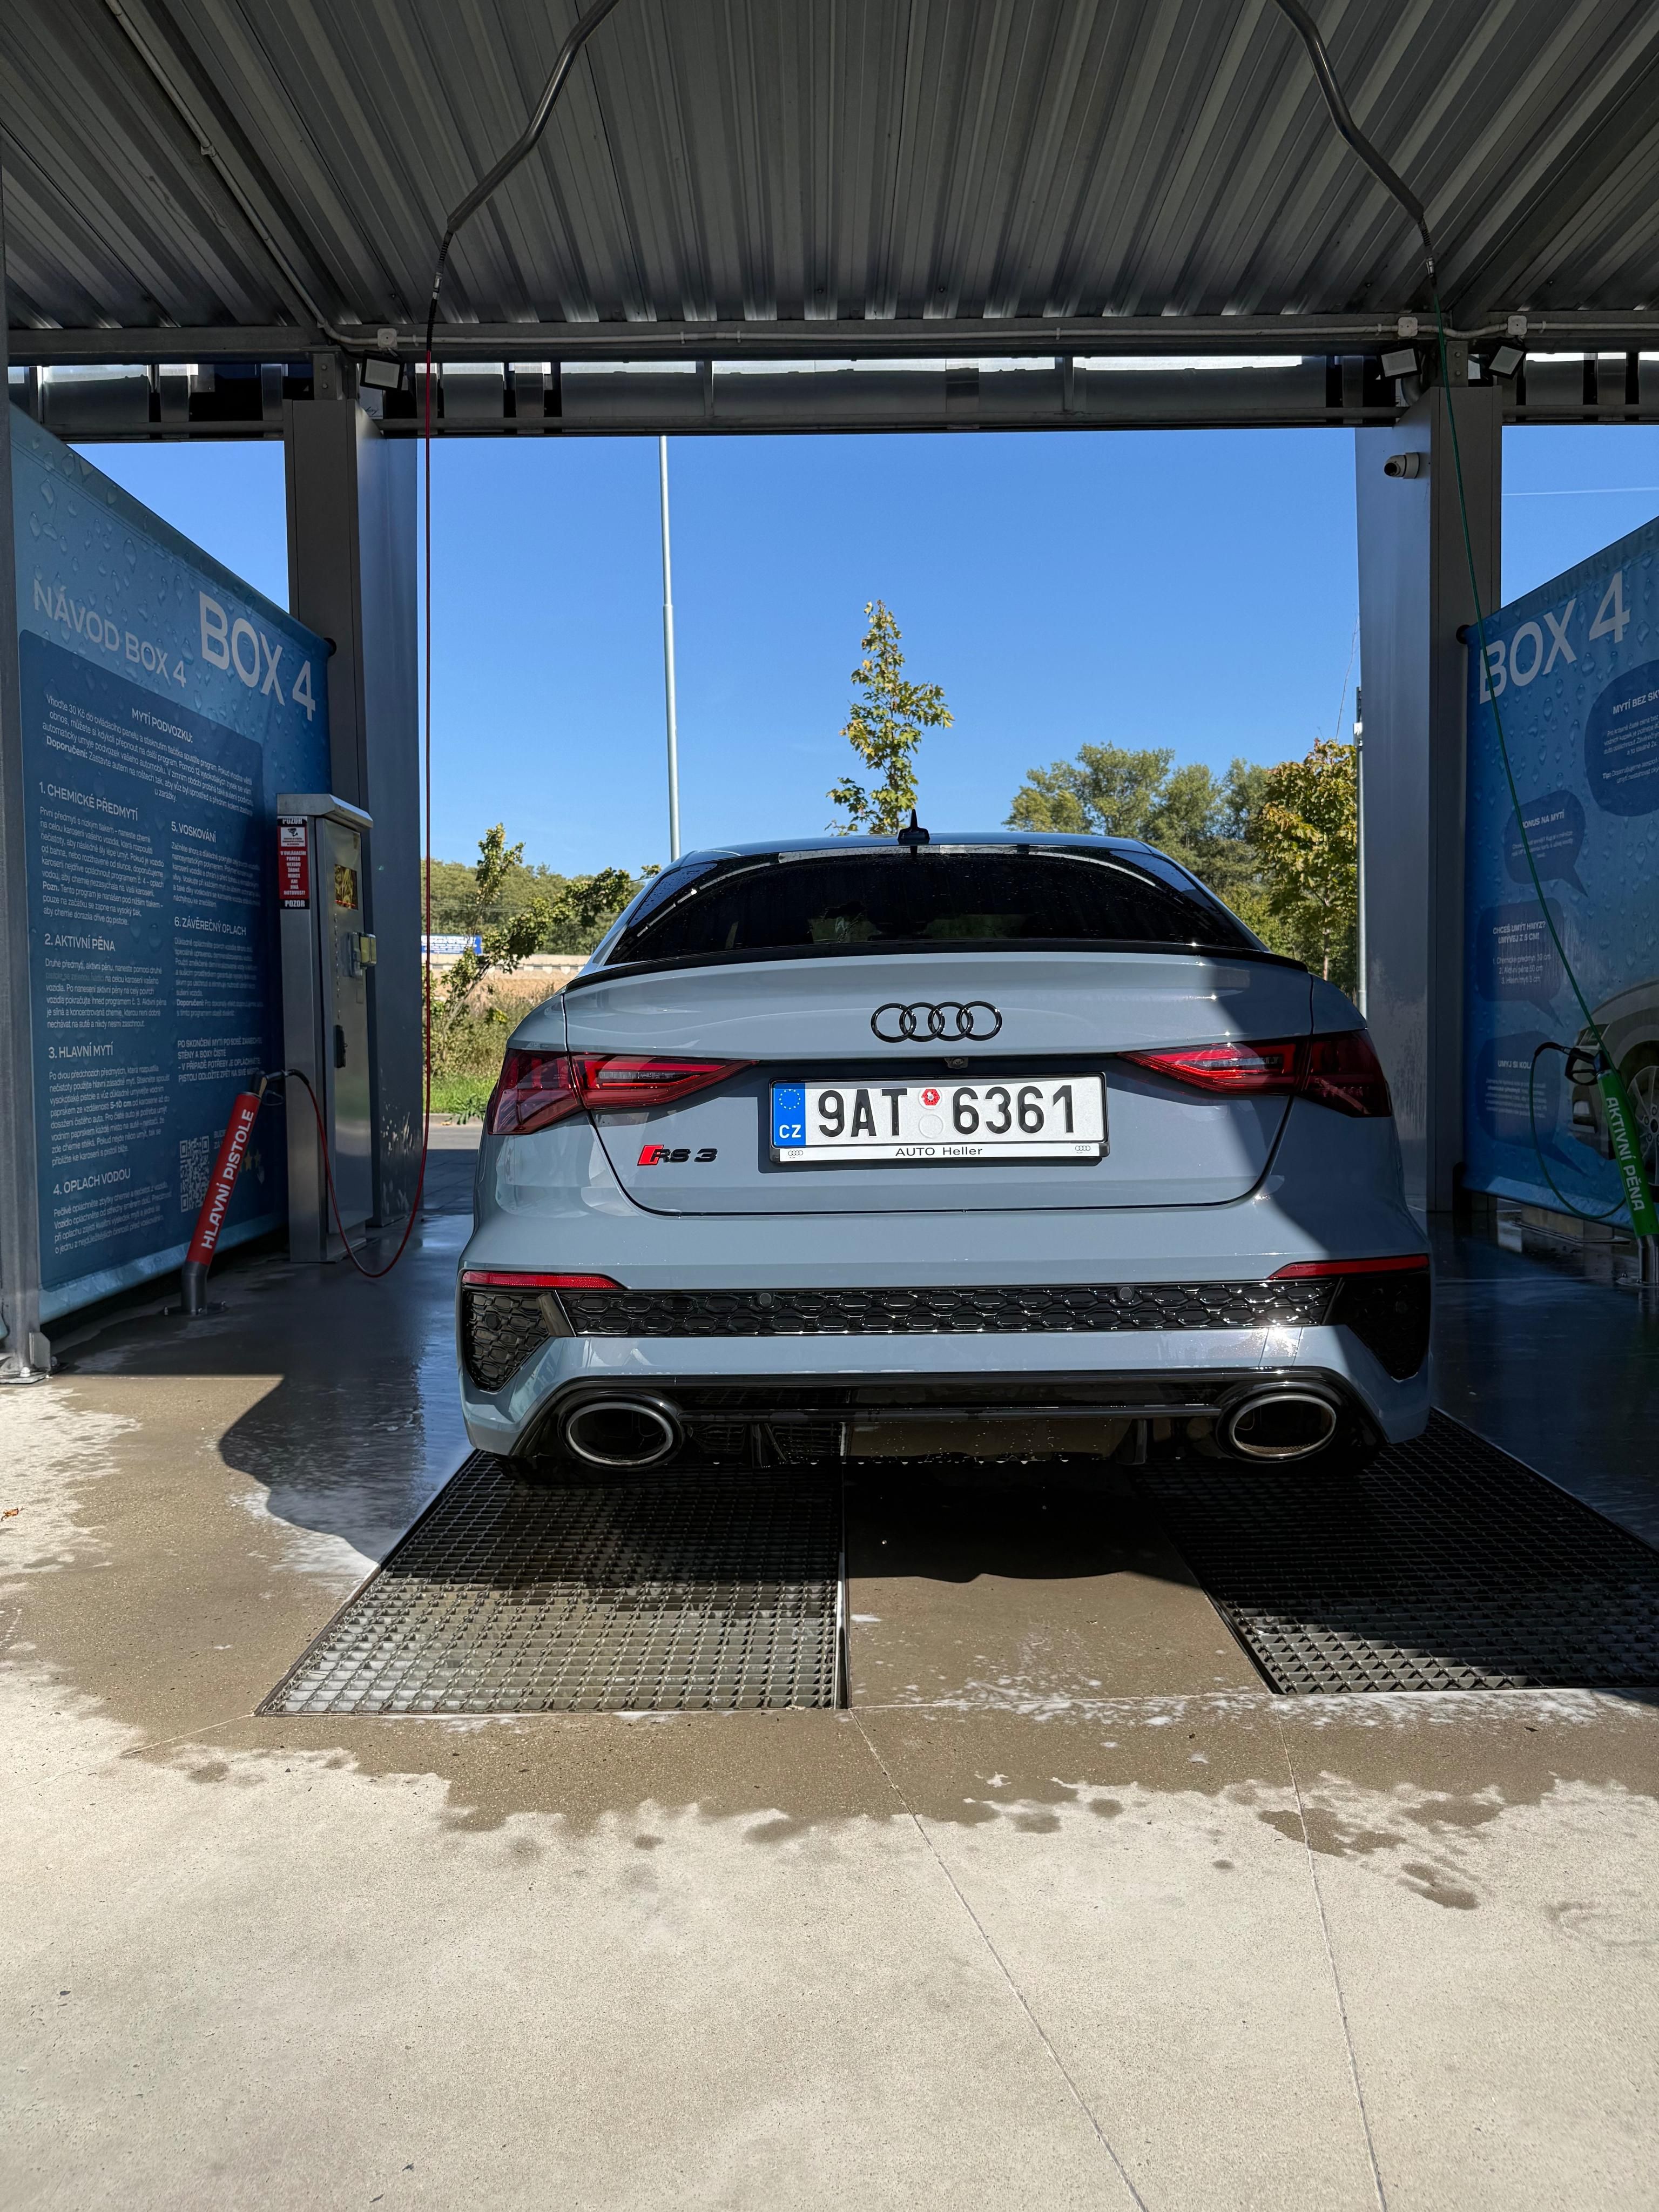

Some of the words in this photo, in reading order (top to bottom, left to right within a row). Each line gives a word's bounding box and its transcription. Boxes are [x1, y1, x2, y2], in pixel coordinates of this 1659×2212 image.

[33, 578, 120, 652] NÁVOD
[125, 631, 171, 686] BOX
[173, 660, 187, 688] 4
[1479, 598, 1577, 705] BOX
[1589, 570, 1631, 644] 4
[199, 591, 285, 705] BOX
[292, 660, 316, 722] 4
[69, 704, 76, 714] 30
[85, 711, 93, 721] do
[1613, 698, 1631, 715] MYTÍ
[1632, 694, 1647, 708] BEZ
[132, 707, 151, 725] MYTÍ
[152, 717, 193, 744] PODVOZKU:
[39, 780, 46, 794] 1.
[47, 783, 95, 808] CHEMICKÉ
[96, 796, 138, 821] PŘEDMYTÍ
[1541, 815, 1550, 825] NA
[1550, 808, 1565, 821] MYTÍ
[171, 820, 178, 832] 5.
[178, 822, 216, 843] VOSKOVÁNÍ
[42, 881, 59, 892] Pozn.
[174, 916, 181, 927] 6.
[181, 915, 221, 933] ZÁVĚREČNÝ
[222, 923, 246, 936] OPLACH
[1493, 923, 1510, 935] CHCEŠ
[44, 932, 53, 945] 2.
[54, 934, 90, 949] AKTIVNÍ
[91, 935, 116, 952] PĚNA
[1519, 934, 1523, 942] Z
[48, 1046, 57, 1058] 3.
[58, 1042, 92, 1058] HLAVNÍ
[93, 1041, 113, 1056] MYTÍ
[177, 1040, 185, 1048] PO
[195, 1050, 199, 1058] A
[1498, 1060, 1512, 1068] UMYJ
[1513, 1060, 1518, 1068] SI
[110, 1101, 122, 1109] 5-10
[818, 1088, 908, 1137] 9AT
[952, 1085, 1074, 1135] 6361
[779, 1124, 801, 1139] CZ
[646, 1148, 691, 1163] RS
[694, 1148, 718, 1163] 3
[895, 1147, 935, 1157] AUTO
[942, 1146, 983, 1156] Heller
[1606, 1096, 1637, 1161] AKTIVNÍ
[1623, 1164, 1645, 1211] PĚNA
[52, 1183, 62, 1196] 4.
[63, 1174, 100, 1194] OPLACH
[101, 1168, 131, 1185] VODOU
[201, 1184, 231, 1249] HLAVNÍ
[222, 1109, 254, 1181] PISTOLE
